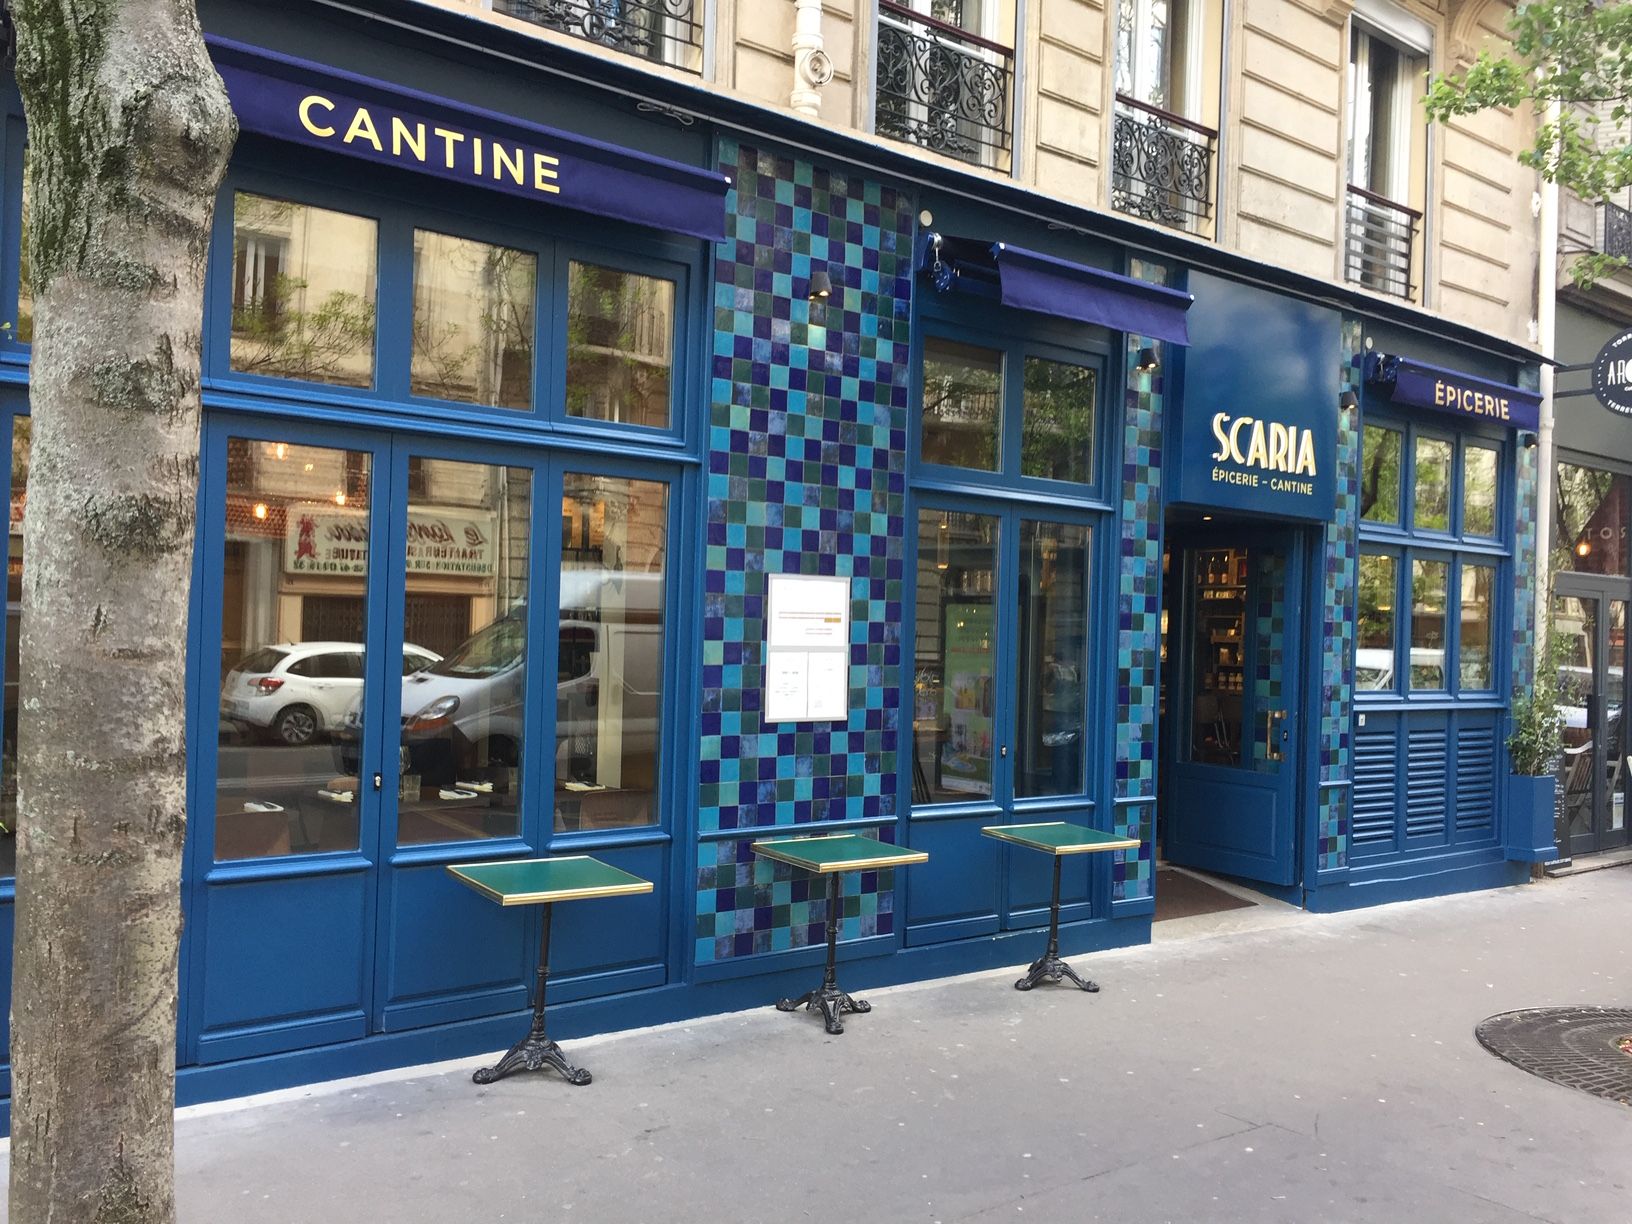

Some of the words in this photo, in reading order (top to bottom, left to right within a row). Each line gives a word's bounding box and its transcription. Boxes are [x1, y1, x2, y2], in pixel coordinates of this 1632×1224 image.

[298, 95, 560, 194] CANTINE
[1435, 380, 1510, 420] ÉPICERIE
[1211, 412, 1317, 476] SCARIA
[1212, 466, 1259, 487] ÉPICERIE
[1270, 478, 1313, 496] CANTINE
